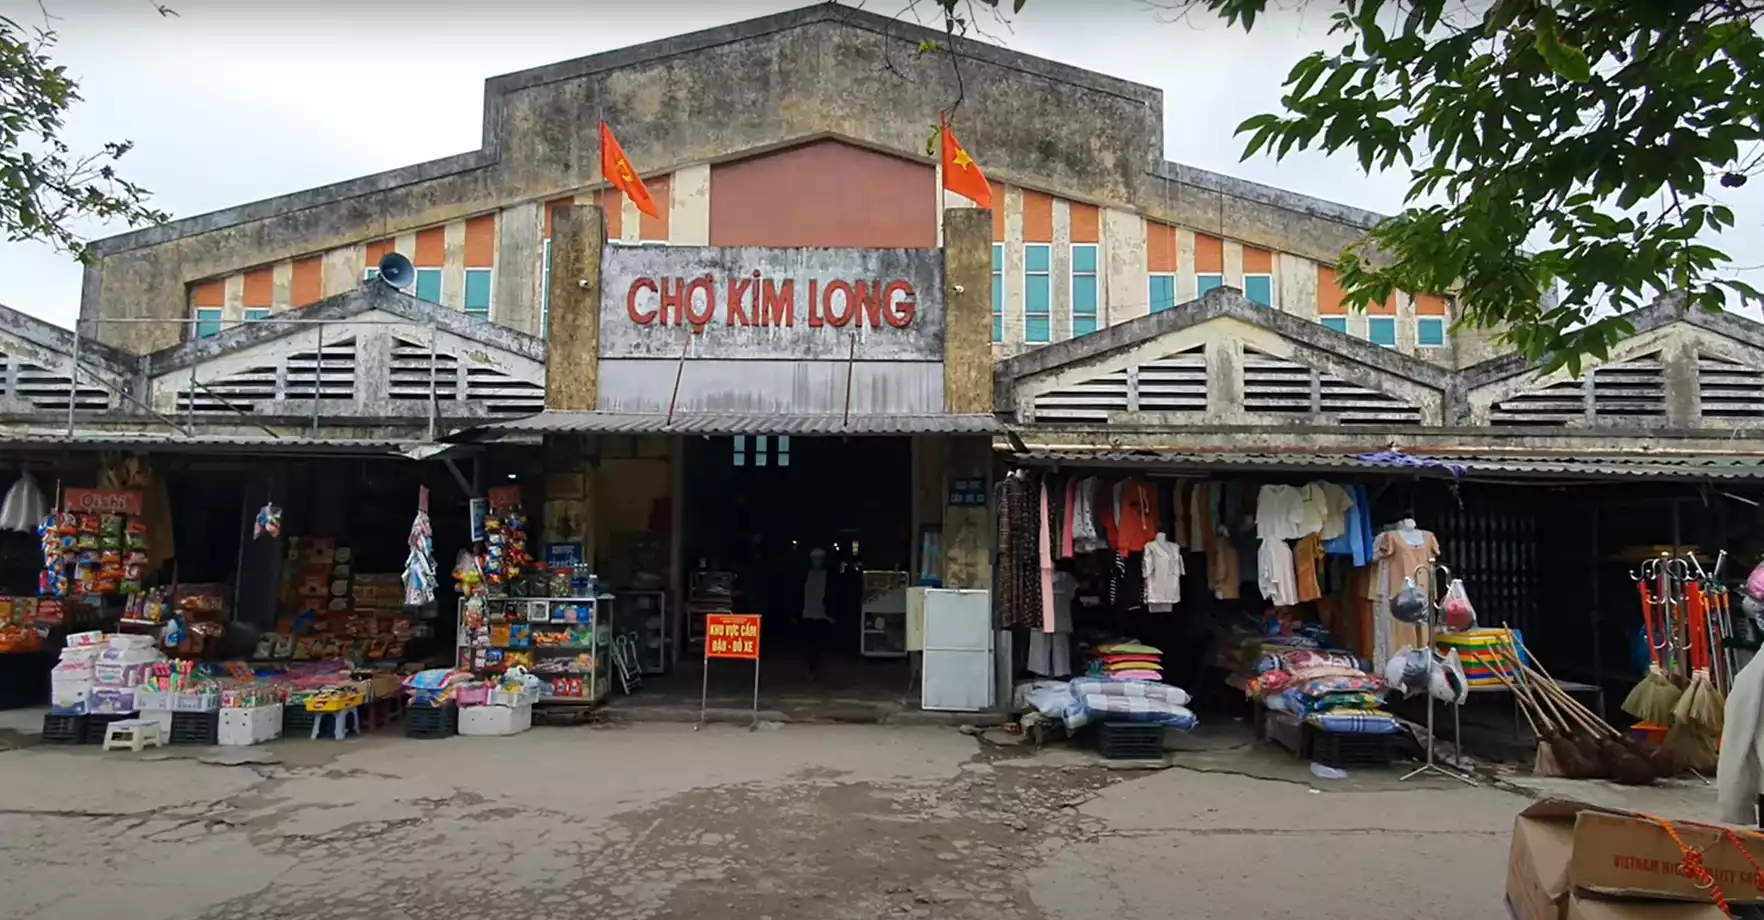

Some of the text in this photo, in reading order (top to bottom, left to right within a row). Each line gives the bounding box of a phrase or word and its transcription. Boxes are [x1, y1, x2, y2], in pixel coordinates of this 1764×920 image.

[626, 272, 715, 334] CHỢ
[807, 278, 918, 328] LONG
[710, 622, 757, 638] KHU VỰC CẤM
[743, 641, 754, 652] XE
[1613, 854, 1659, 873] VIETNAM
[1661, 861, 1683, 876] HIG
